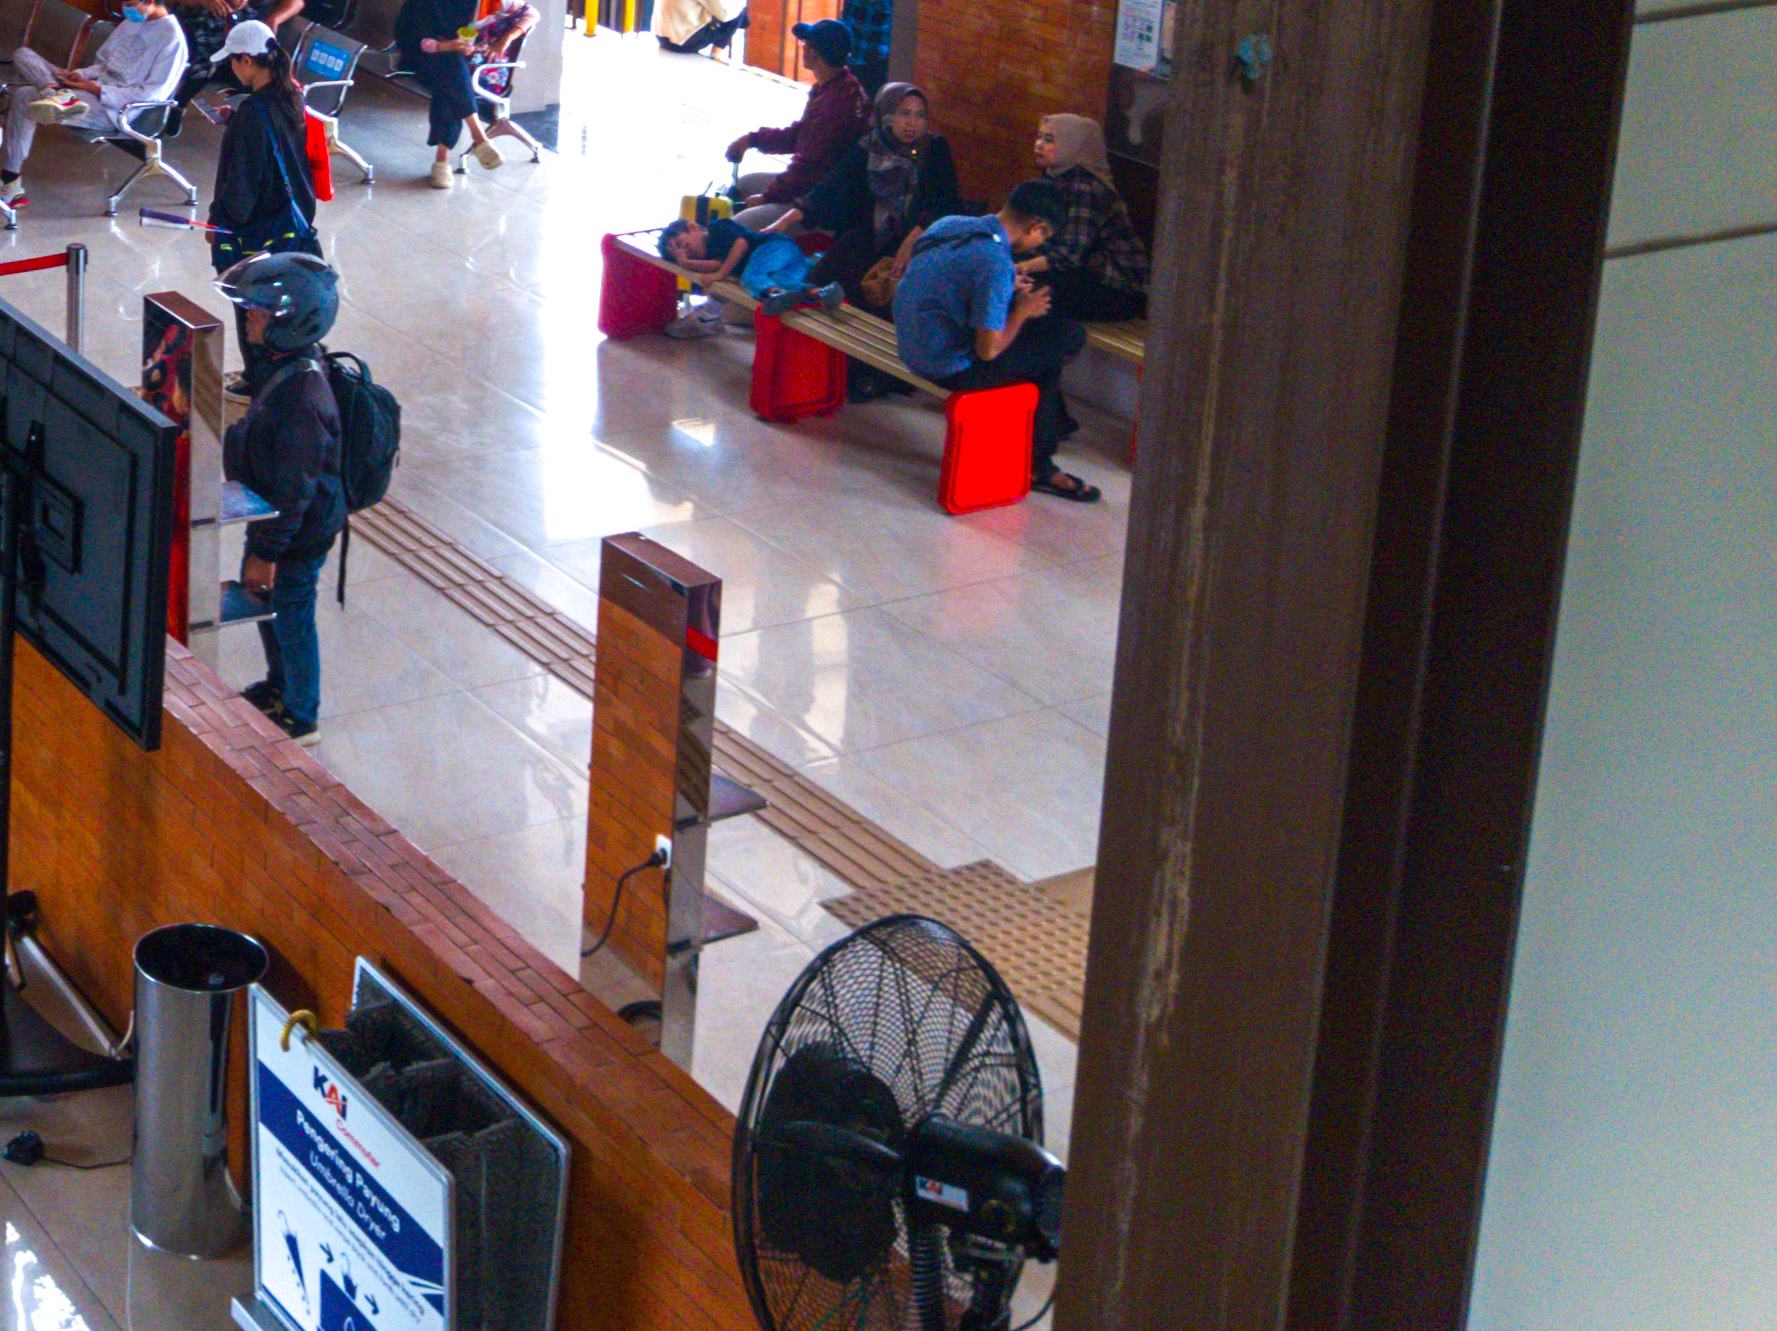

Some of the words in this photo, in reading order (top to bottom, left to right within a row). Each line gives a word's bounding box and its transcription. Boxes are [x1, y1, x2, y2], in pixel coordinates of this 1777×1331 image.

[313, 1065, 348, 1120] KAI
[296, 1109, 353, 1184] Pengering
[355, 1171, 401, 1234] Payung
[310, 1150, 355, 1208] Umbrella
[357, 1200, 387, 1240] Dryer
